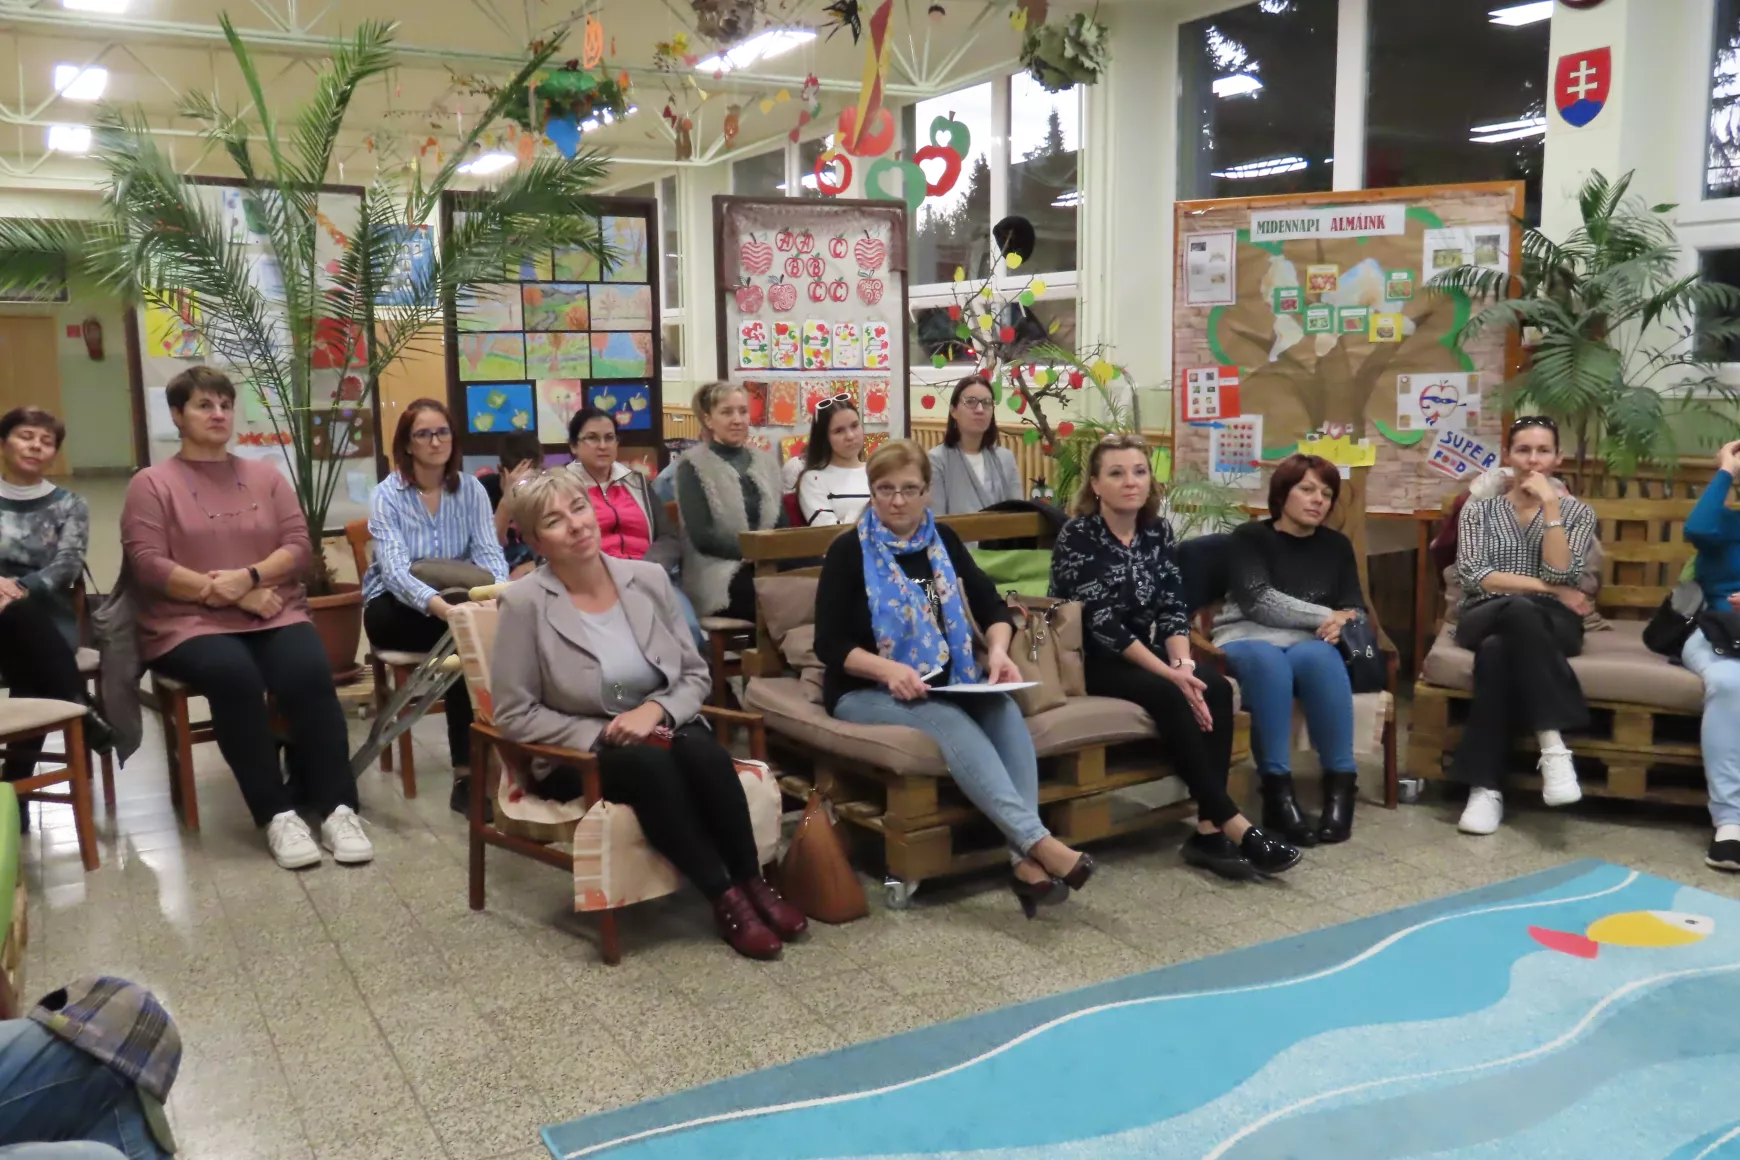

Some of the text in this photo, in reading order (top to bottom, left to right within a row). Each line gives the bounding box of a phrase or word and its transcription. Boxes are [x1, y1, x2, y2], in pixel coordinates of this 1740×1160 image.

[1256, 212, 1386, 234] MIDENNAPI ALMÁINK
[1440, 430, 1497, 468] SUPER
